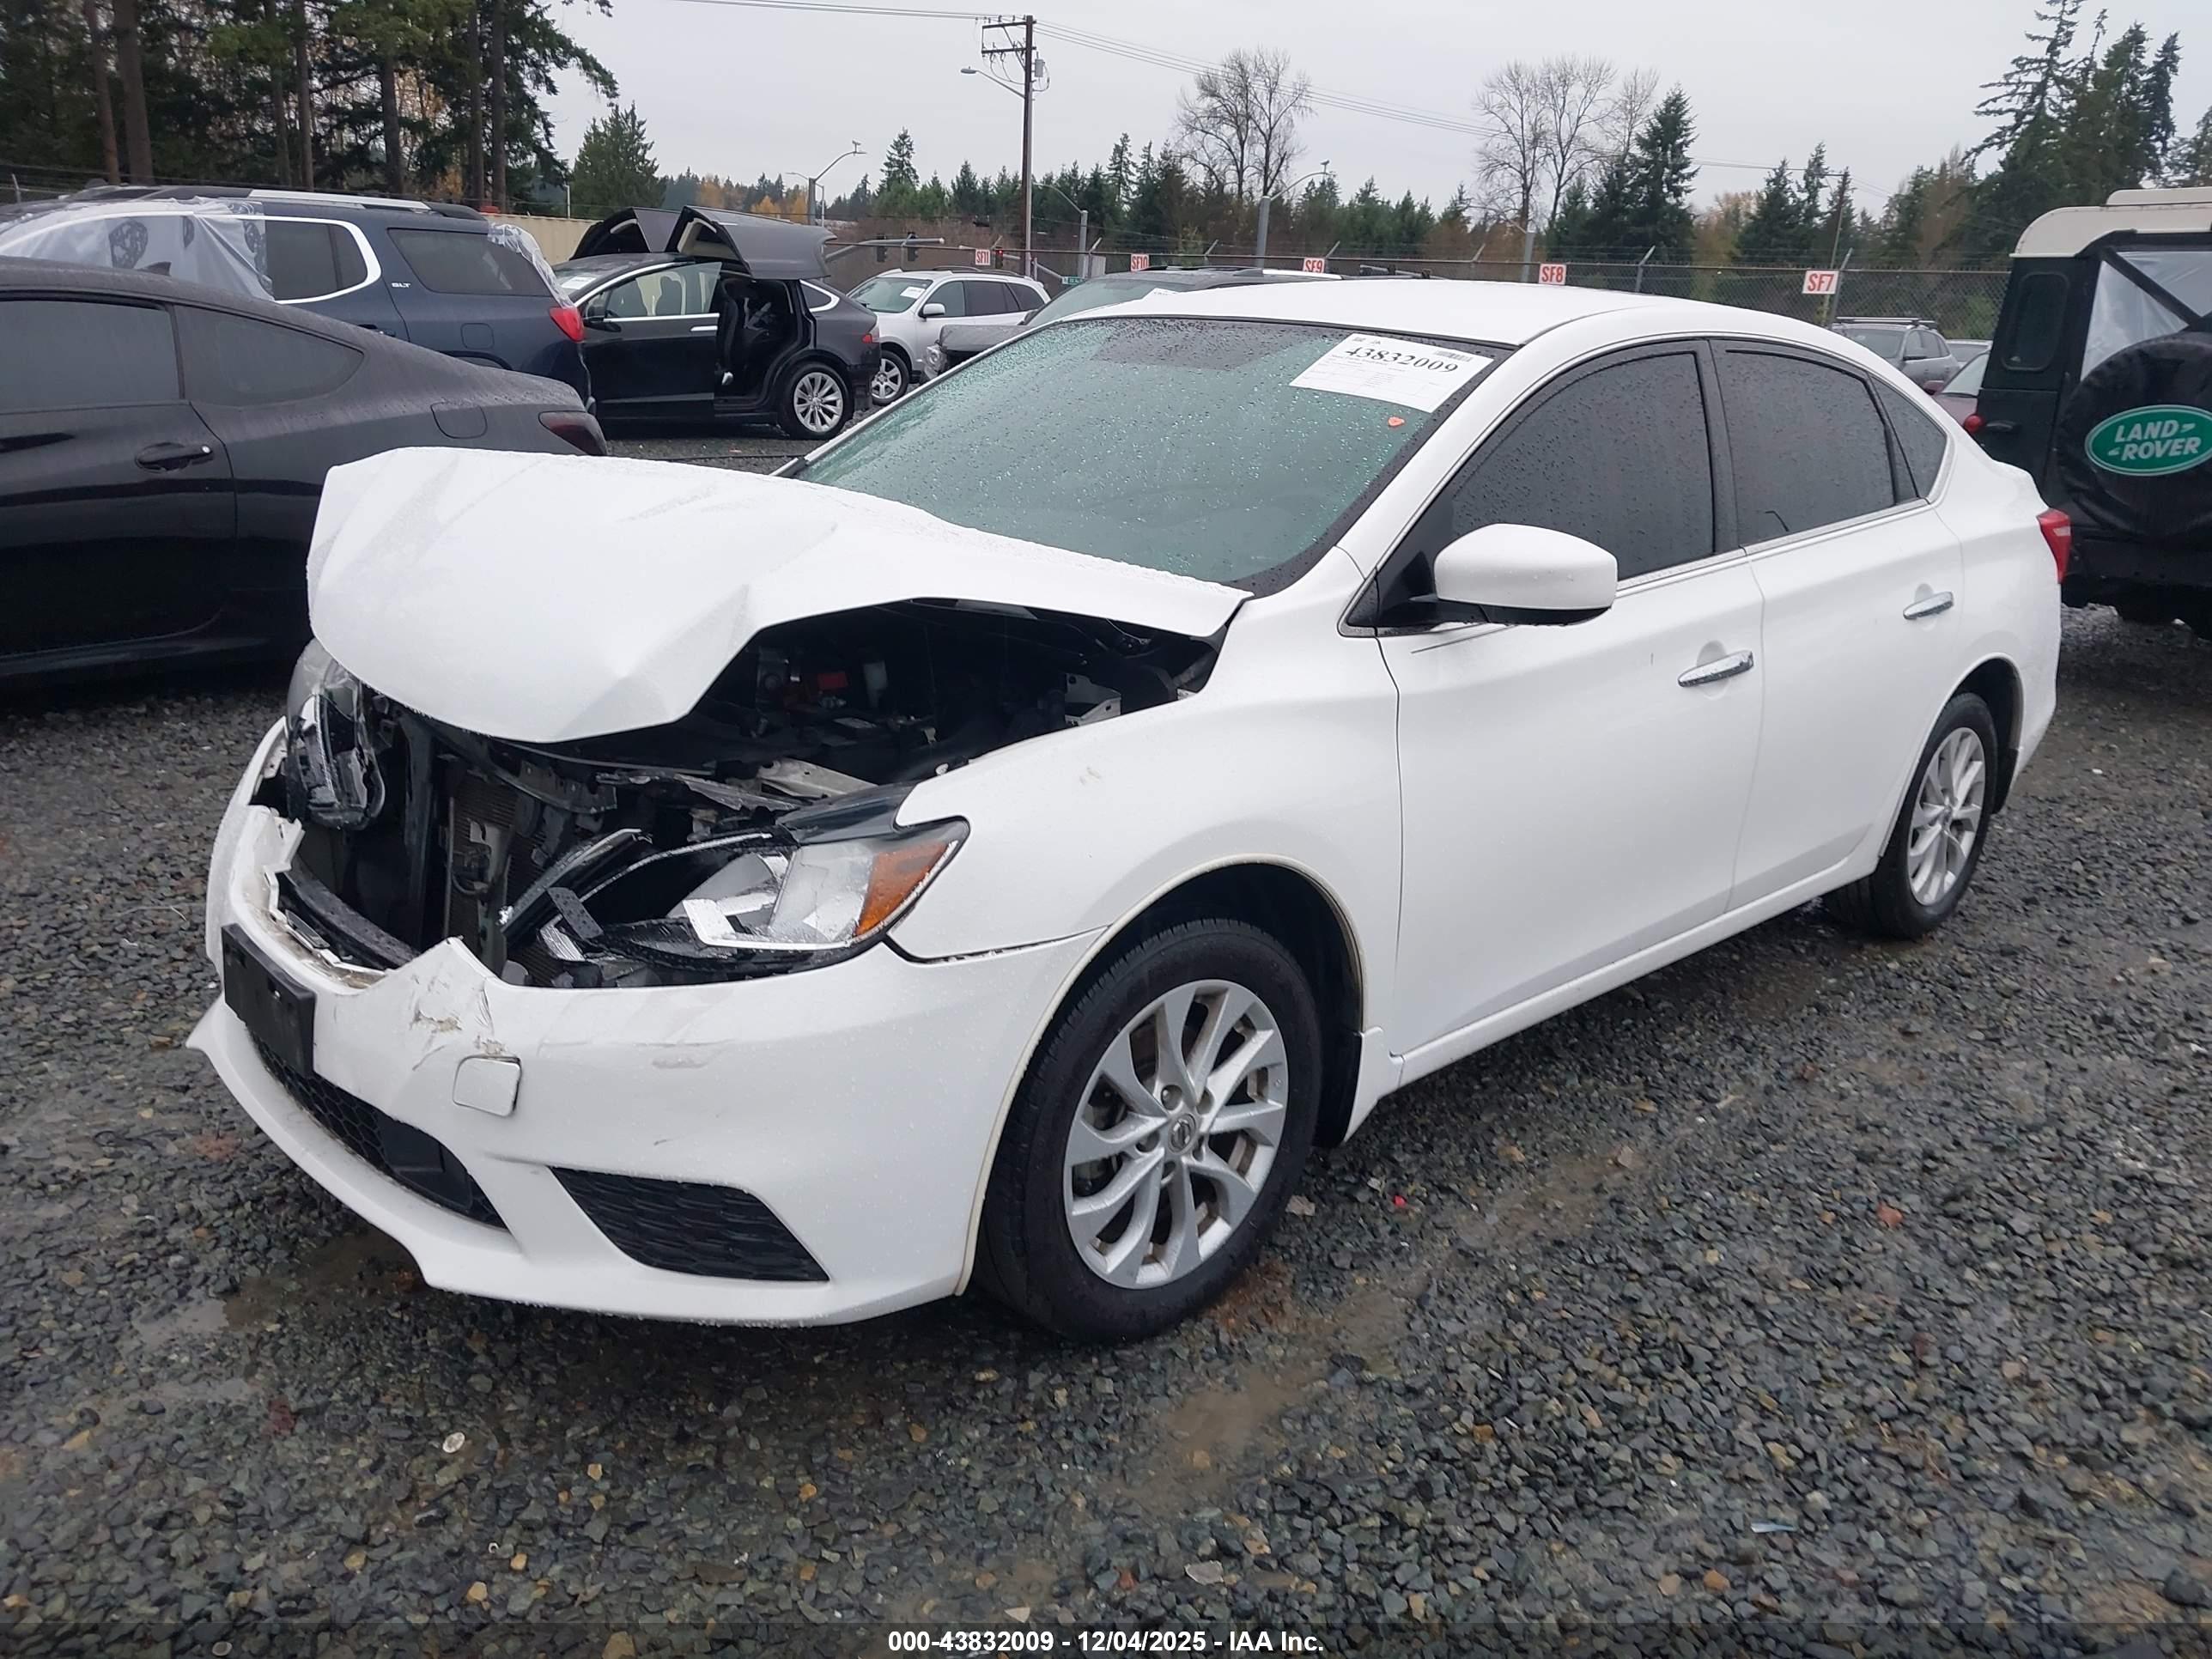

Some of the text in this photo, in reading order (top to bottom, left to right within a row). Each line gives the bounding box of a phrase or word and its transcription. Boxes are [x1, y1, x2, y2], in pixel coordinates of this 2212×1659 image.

[976, 251, 989, 264] SF11
[1132, 255, 1148, 270] SF10
[1305, 259, 1322, 273] SF9
[1541, 266, 1564, 283] SF8
[1808, 273, 1835, 292] SF7
[1345, 346, 1459, 373] 43832009
[2114, 419, 2180, 443] LAND
[2120, 436, 2202, 461] ROVER
